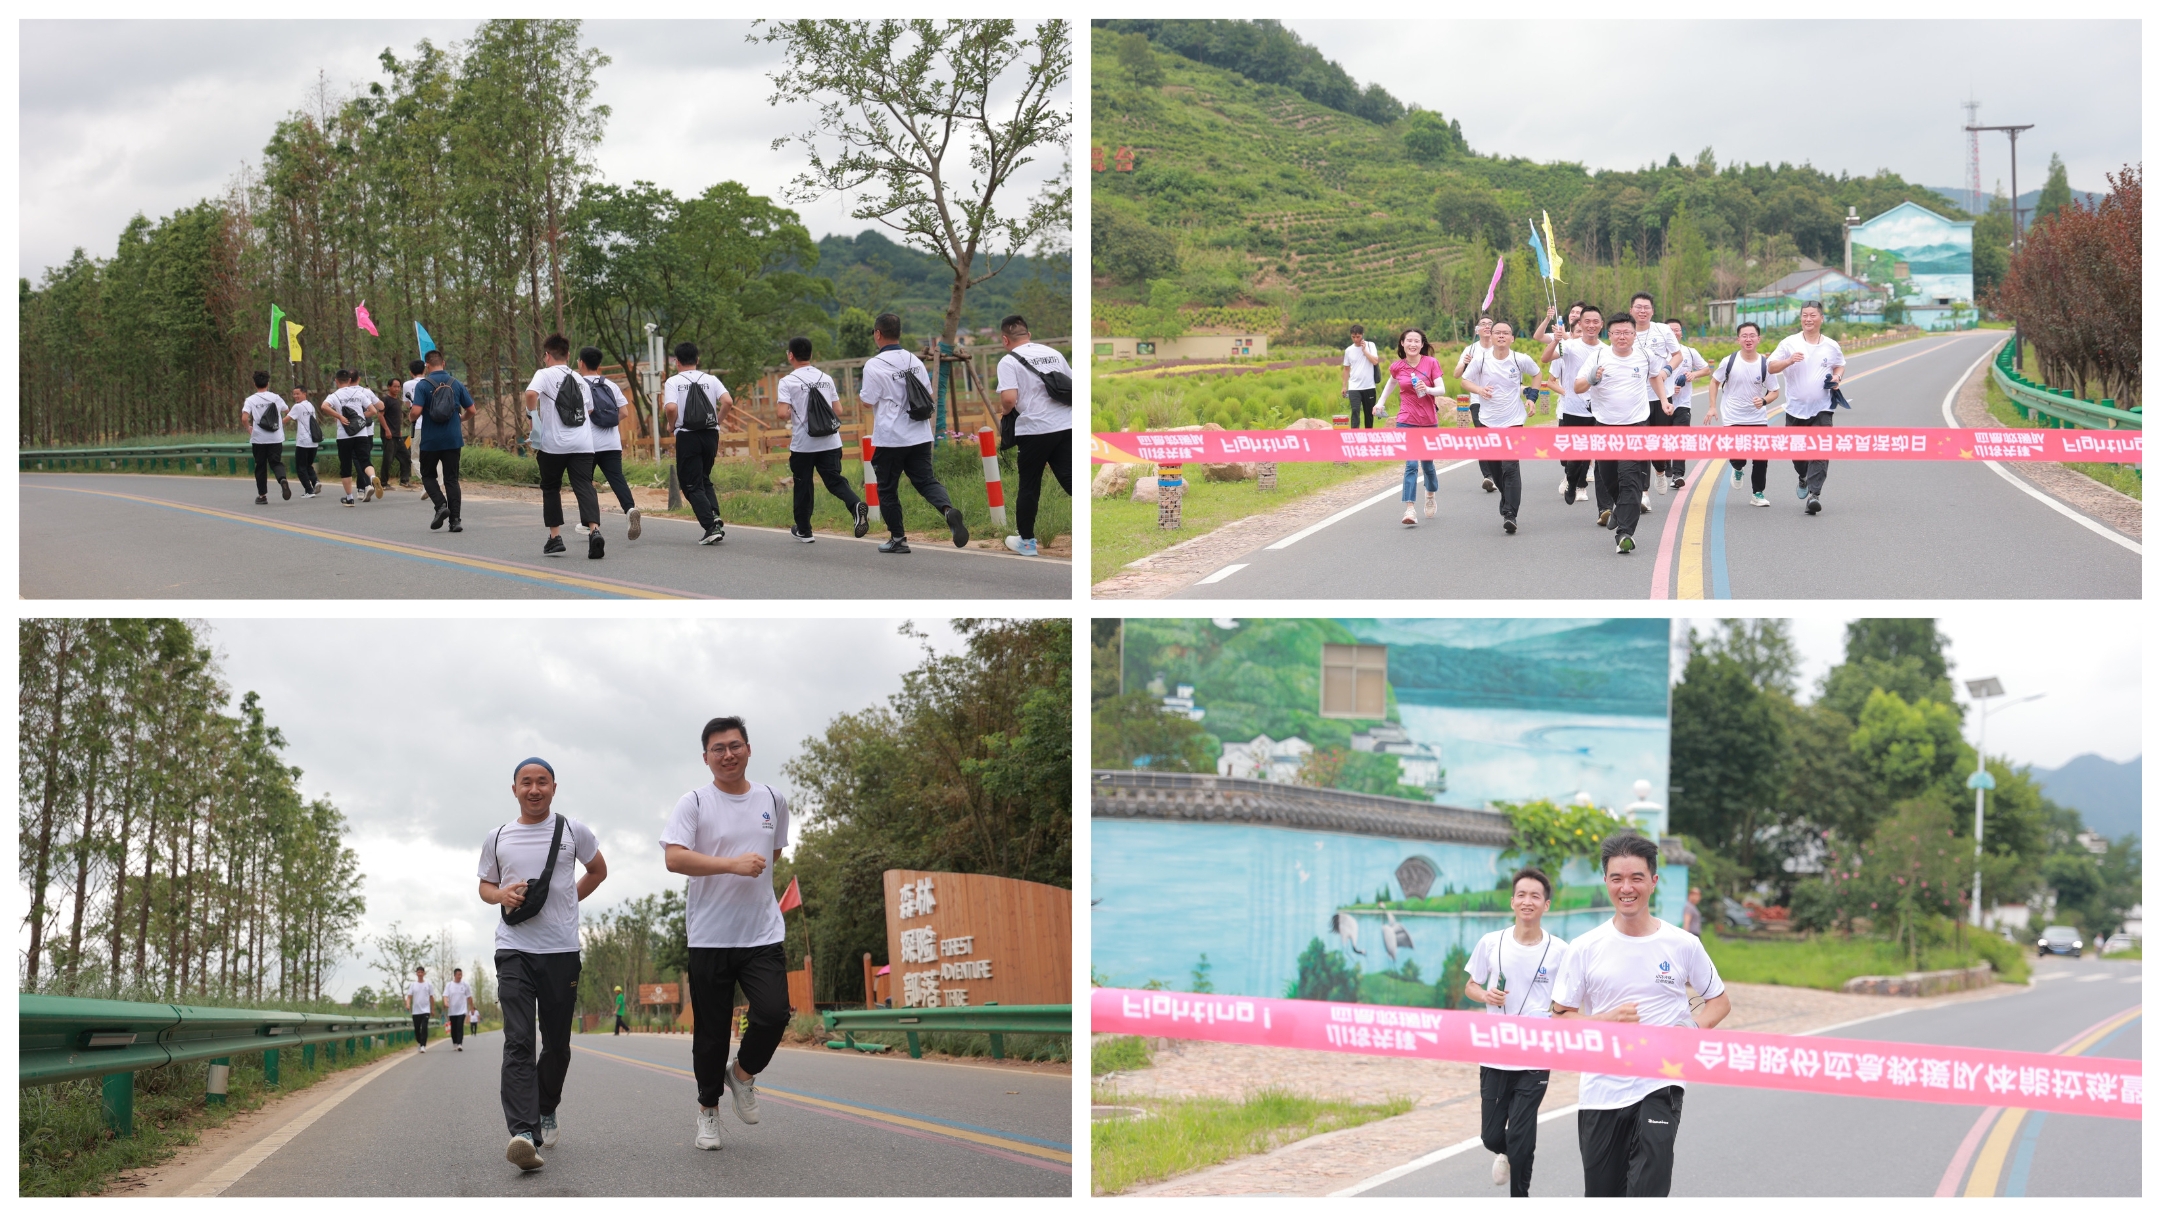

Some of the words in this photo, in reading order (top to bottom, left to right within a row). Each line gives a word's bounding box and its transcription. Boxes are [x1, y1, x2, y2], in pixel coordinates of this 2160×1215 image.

[899, 877, 937, 919] 森林
[901, 925, 939, 963] 探险
[903, 969, 941, 1008] 部落
